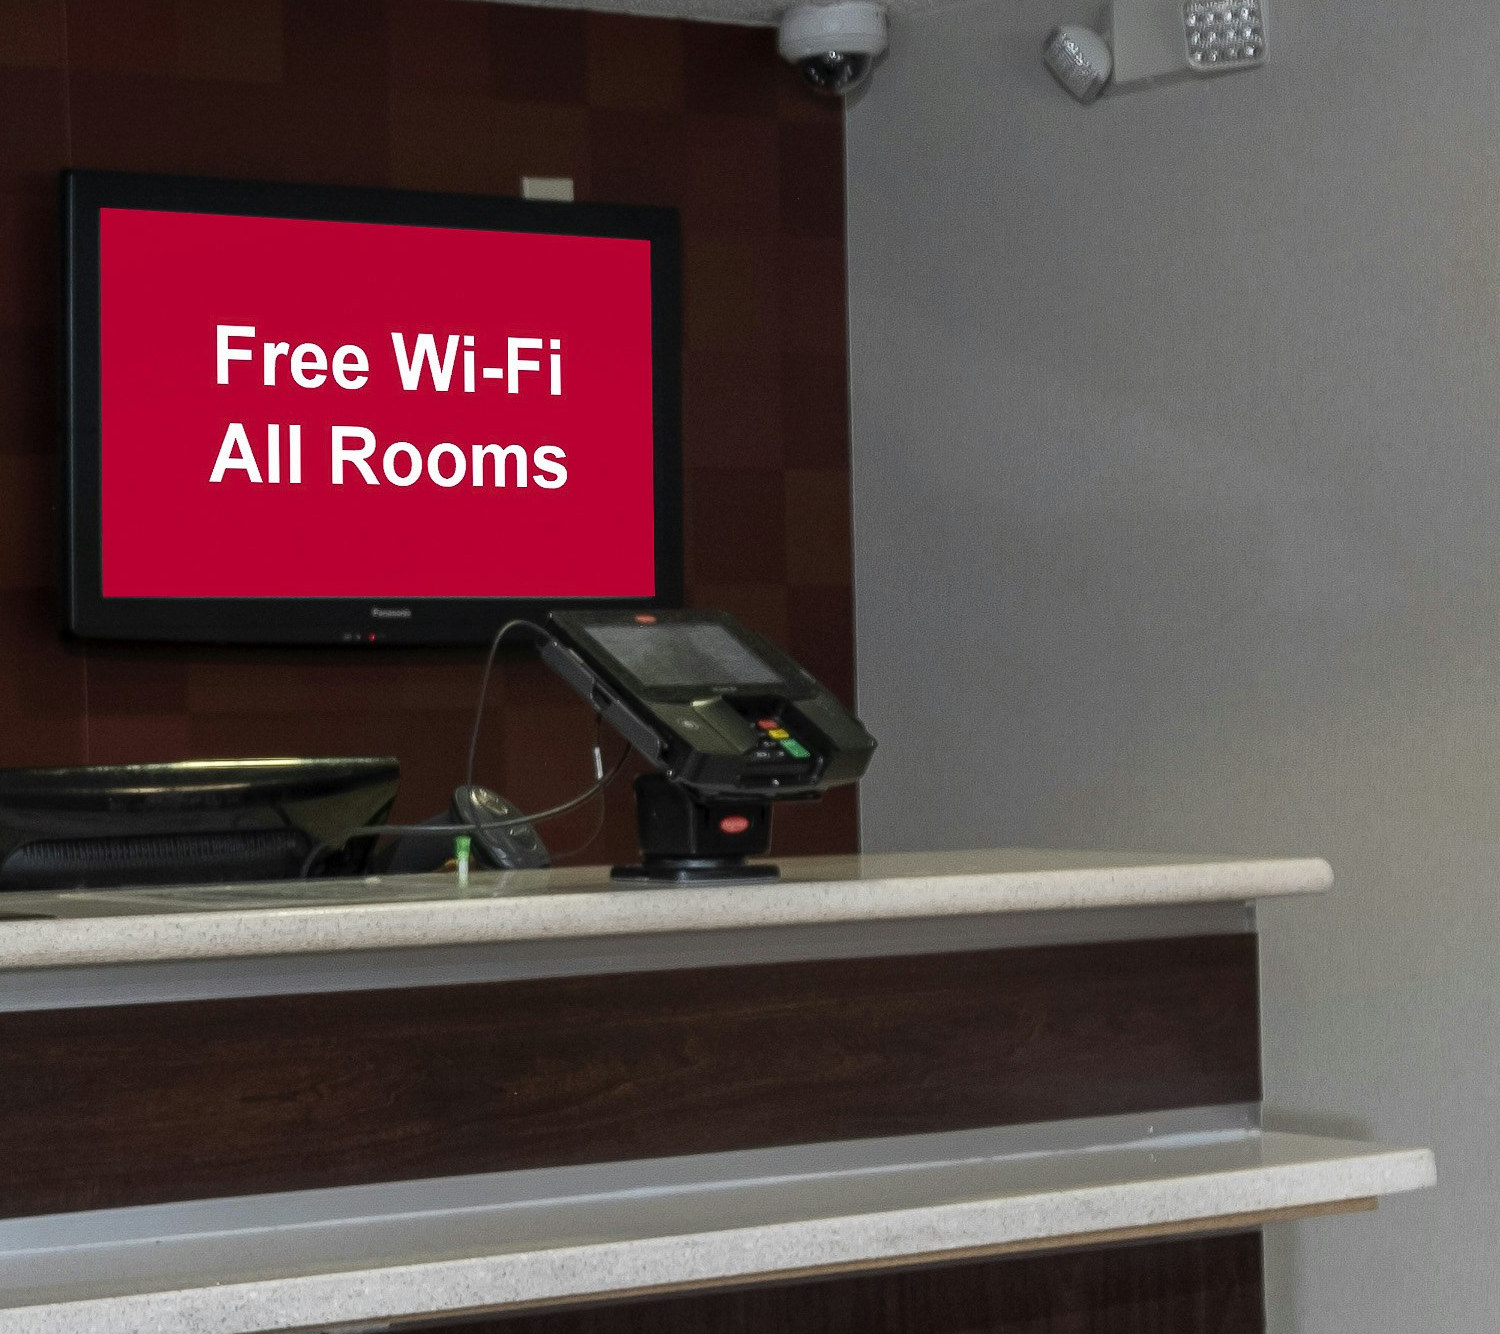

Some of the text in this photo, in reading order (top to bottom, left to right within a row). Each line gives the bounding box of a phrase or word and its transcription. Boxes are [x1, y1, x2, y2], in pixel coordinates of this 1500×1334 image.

[216, 324, 562, 396] Free Wi-Fi
[208, 422, 568, 490] All Rooms
